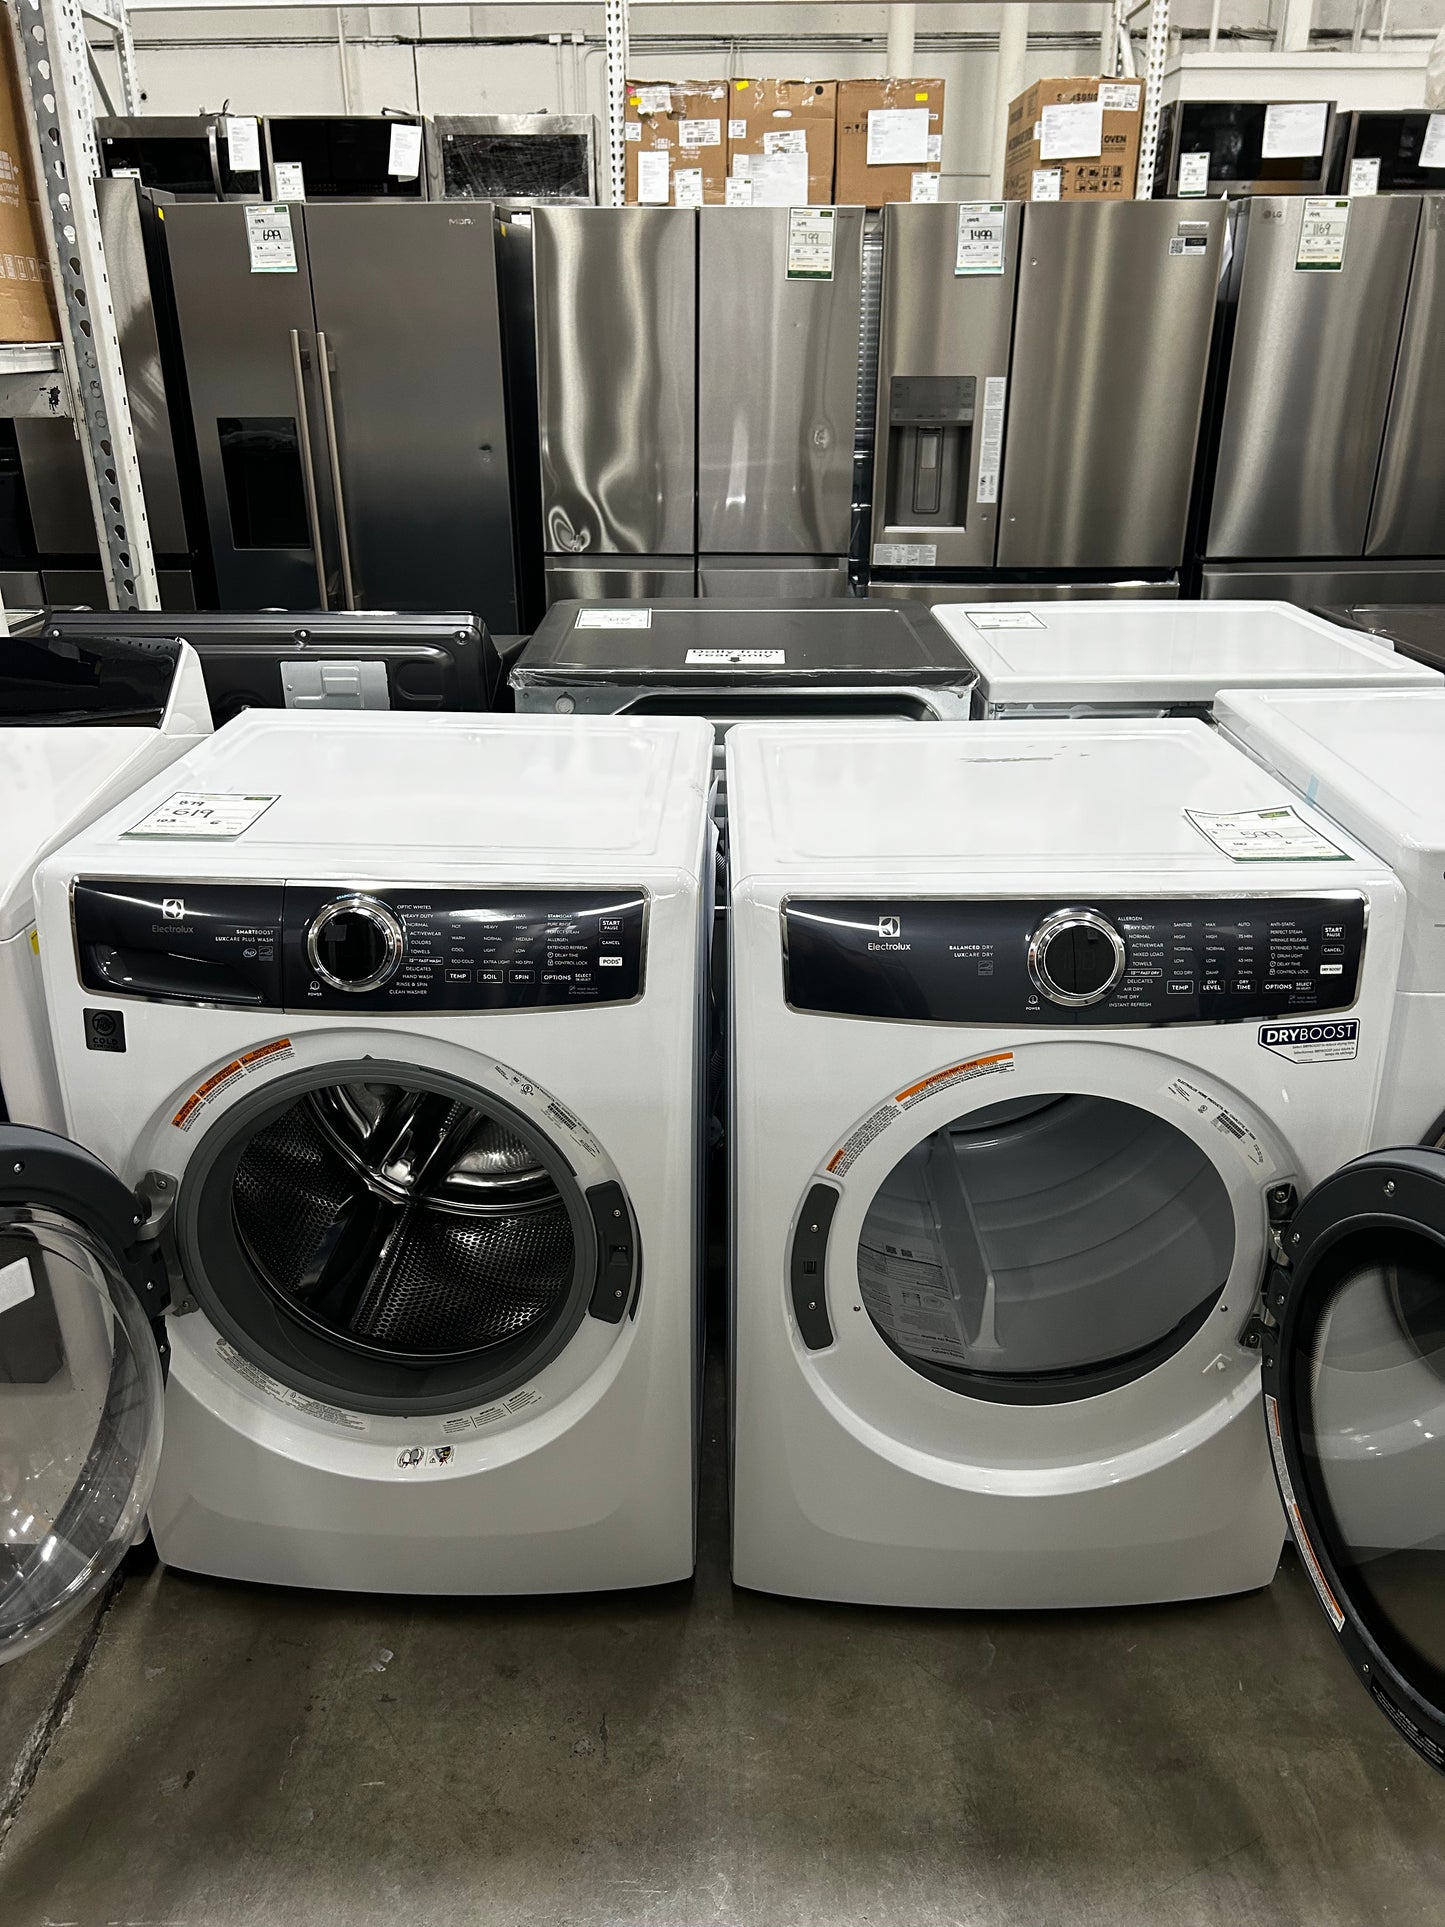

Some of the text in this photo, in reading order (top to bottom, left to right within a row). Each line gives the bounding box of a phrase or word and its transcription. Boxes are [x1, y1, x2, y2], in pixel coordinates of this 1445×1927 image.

[1057, 92, 1098, 102] SSUNG
[1104, 135, 1126, 143] OVEN
[1313, 223, 1331, 235] 1169
[263, 230, 282, 240] 699
[801, 233, 819, 244] 799
[971, 229, 992, 240] 1499
[172, 809, 215, 818] 619
[1240, 830, 1283, 838] 599
[152, 925, 194, 933] Electrolux
[868, 943, 911, 951] Electrolux
[1267, 1025, 1353, 1042] DRYBOOST
